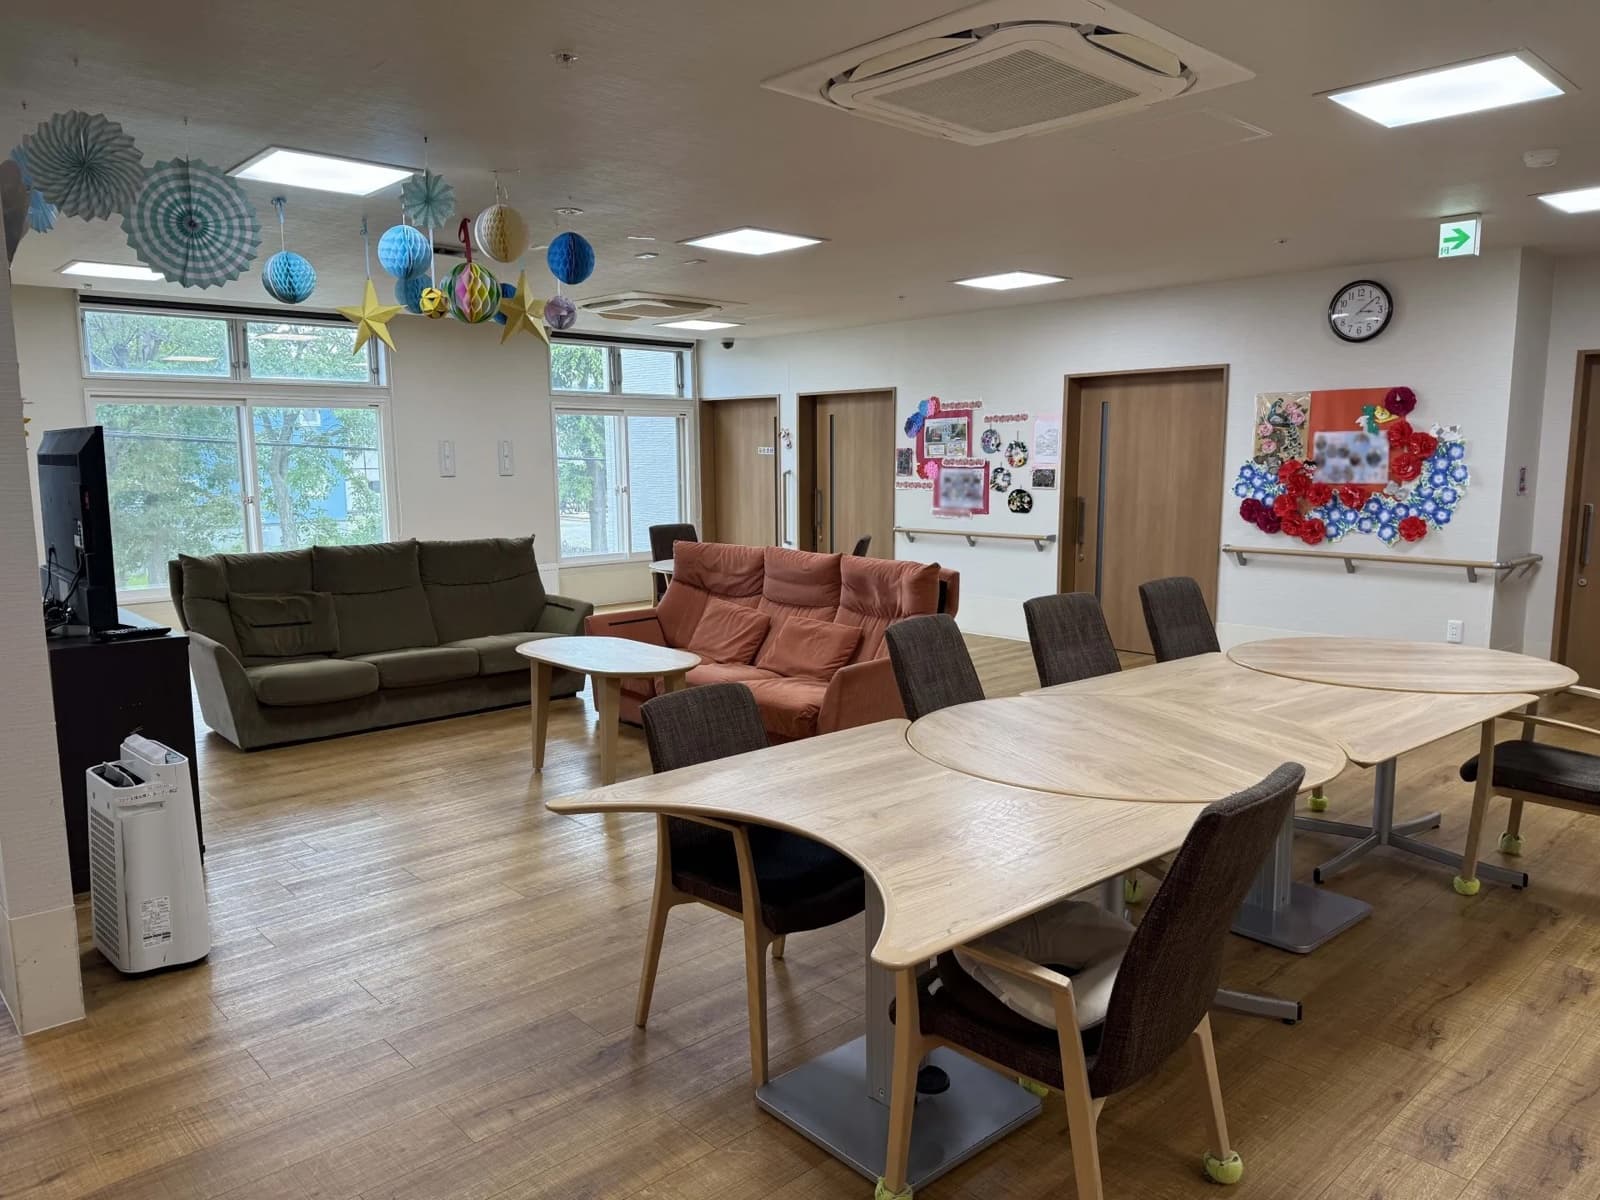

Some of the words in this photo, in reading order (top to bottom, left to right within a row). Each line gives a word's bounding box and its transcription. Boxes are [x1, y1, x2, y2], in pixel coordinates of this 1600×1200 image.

[1348, 292, 1354, 301] 11
[1358, 288, 1366, 297] 12
[1378, 305, 1383, 314] 3
[1356, 326, 1362, 335] 6
[1366, 323, 1372, 331] 5
